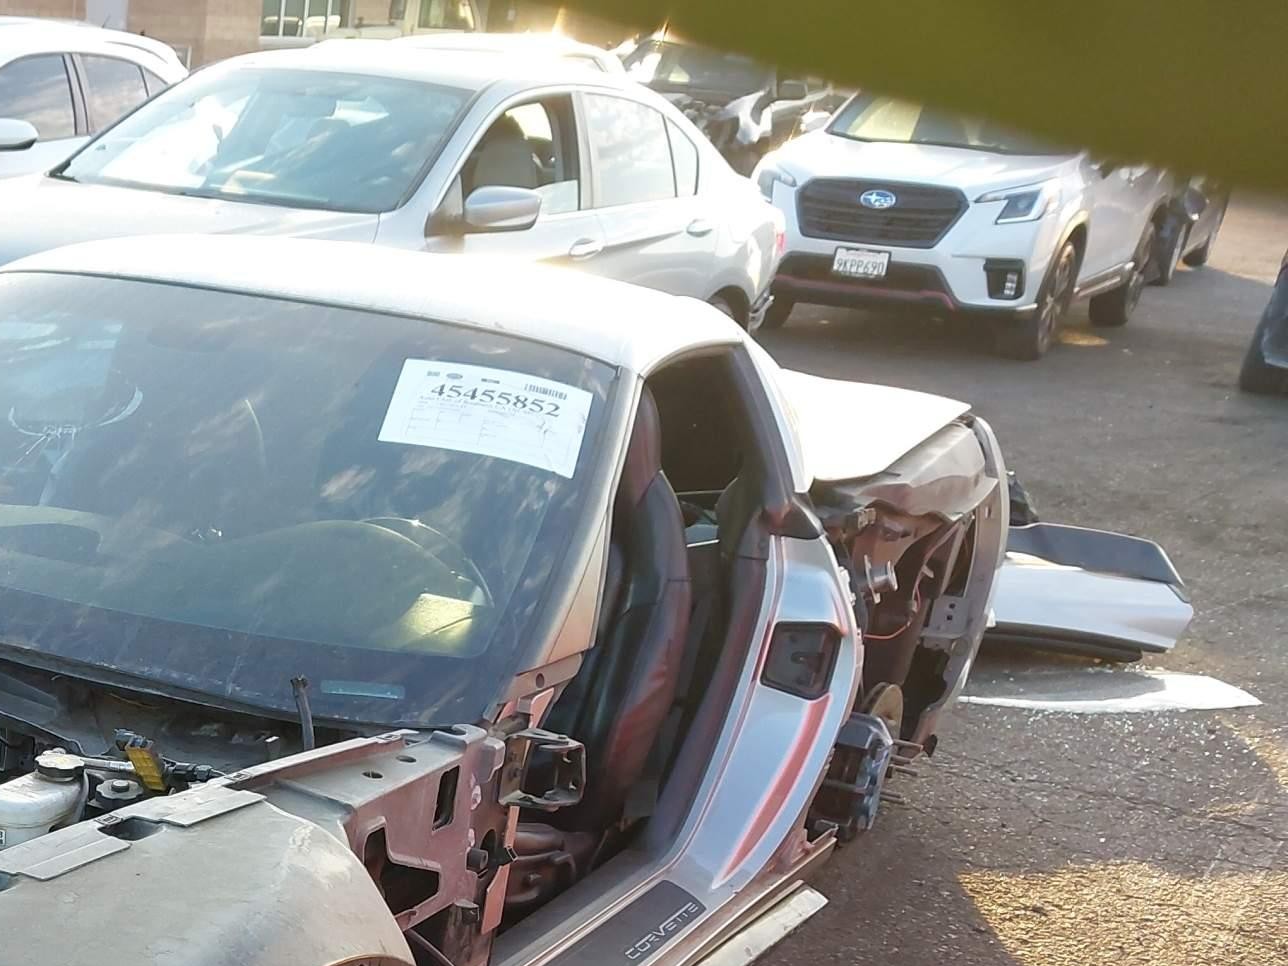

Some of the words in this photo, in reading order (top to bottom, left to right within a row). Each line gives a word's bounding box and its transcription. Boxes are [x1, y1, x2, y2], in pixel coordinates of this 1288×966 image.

[836, 257, 885, 274] 9KPP690
[430, 382, 561, 418] 45455852
[624, 901, 699, 960] CORVETTE
